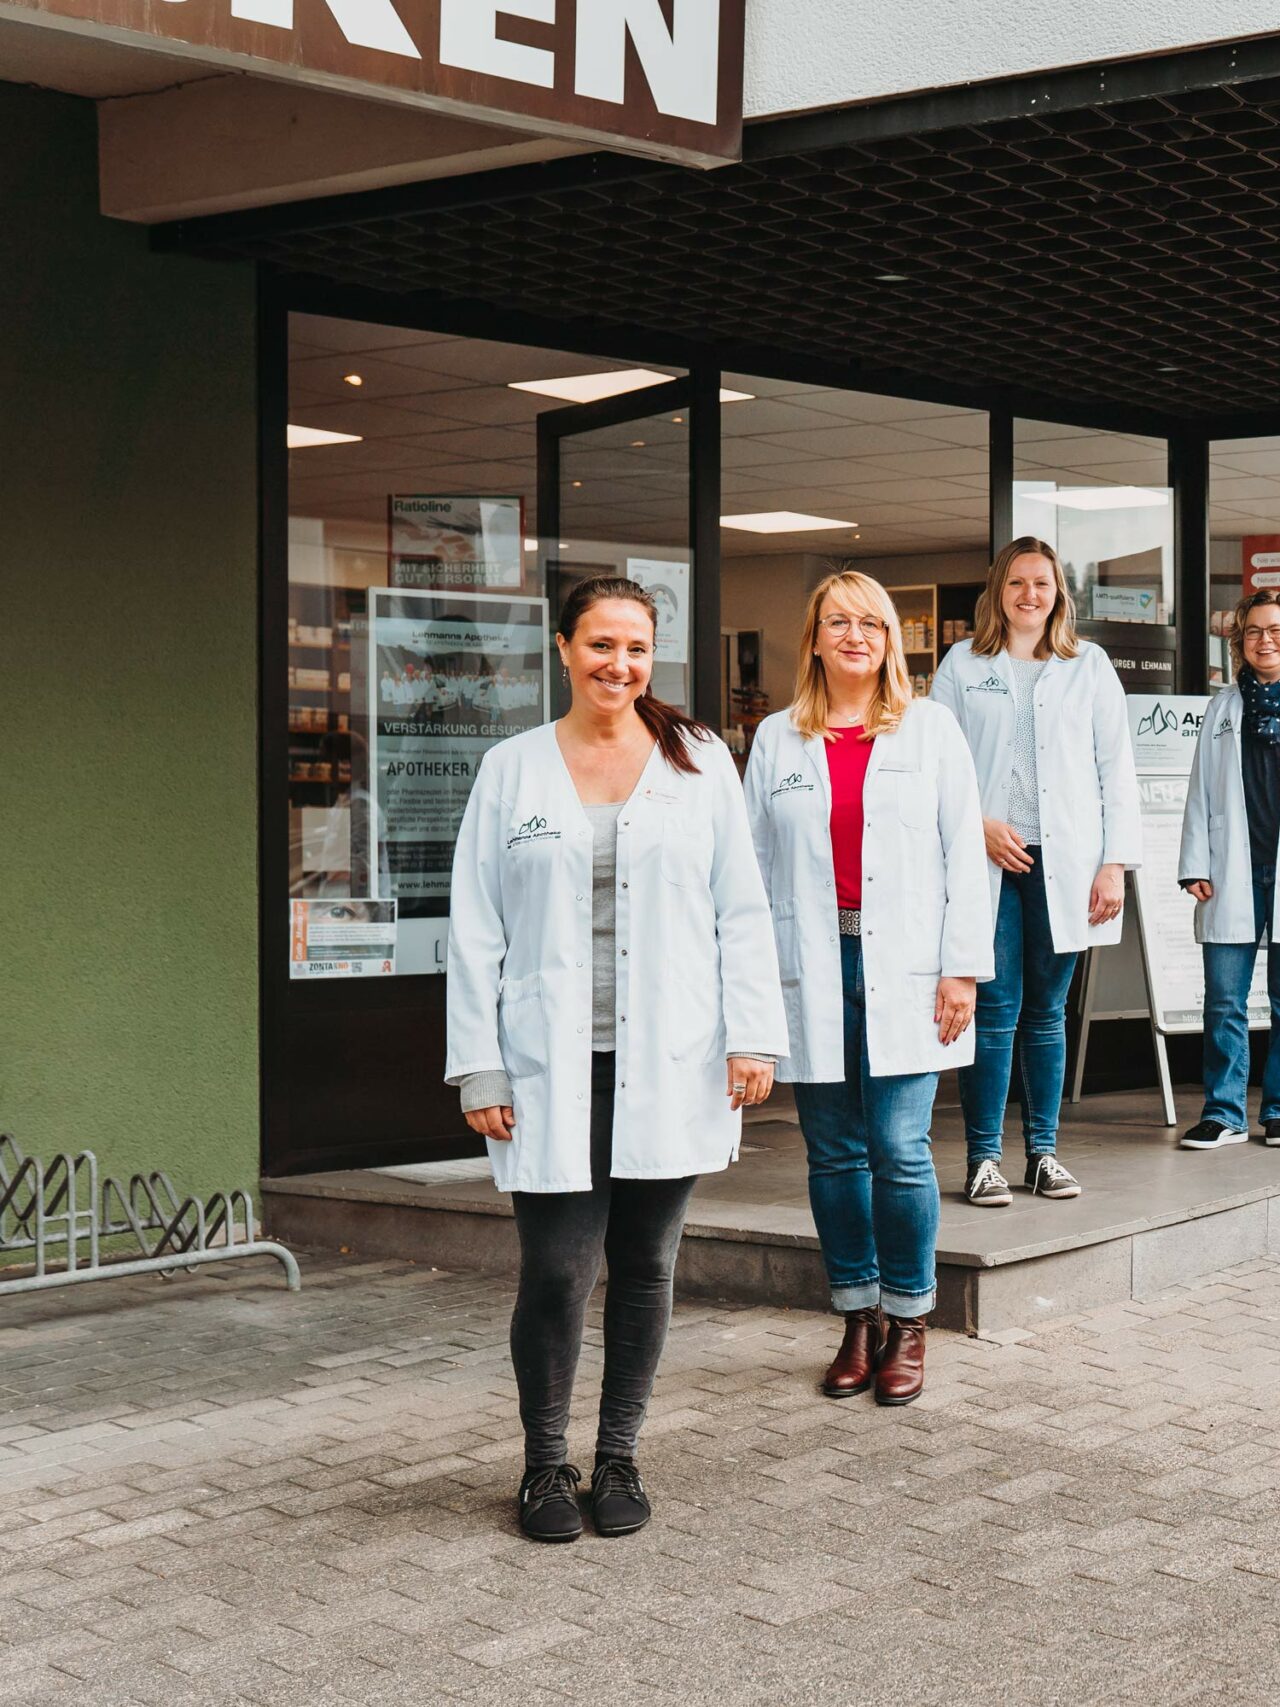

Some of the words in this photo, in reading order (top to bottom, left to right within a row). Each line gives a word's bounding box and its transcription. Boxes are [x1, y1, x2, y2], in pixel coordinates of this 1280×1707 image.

[394, 501, 452, 512] Ratioline
[1141, 660, 1172, 671] LEHMANN
[384, 721, 478, 736] VERSTÄRKUNG
[386, 761, 470, 777] APOTHEKER
[309, 962, 333, 971] ZONTA
